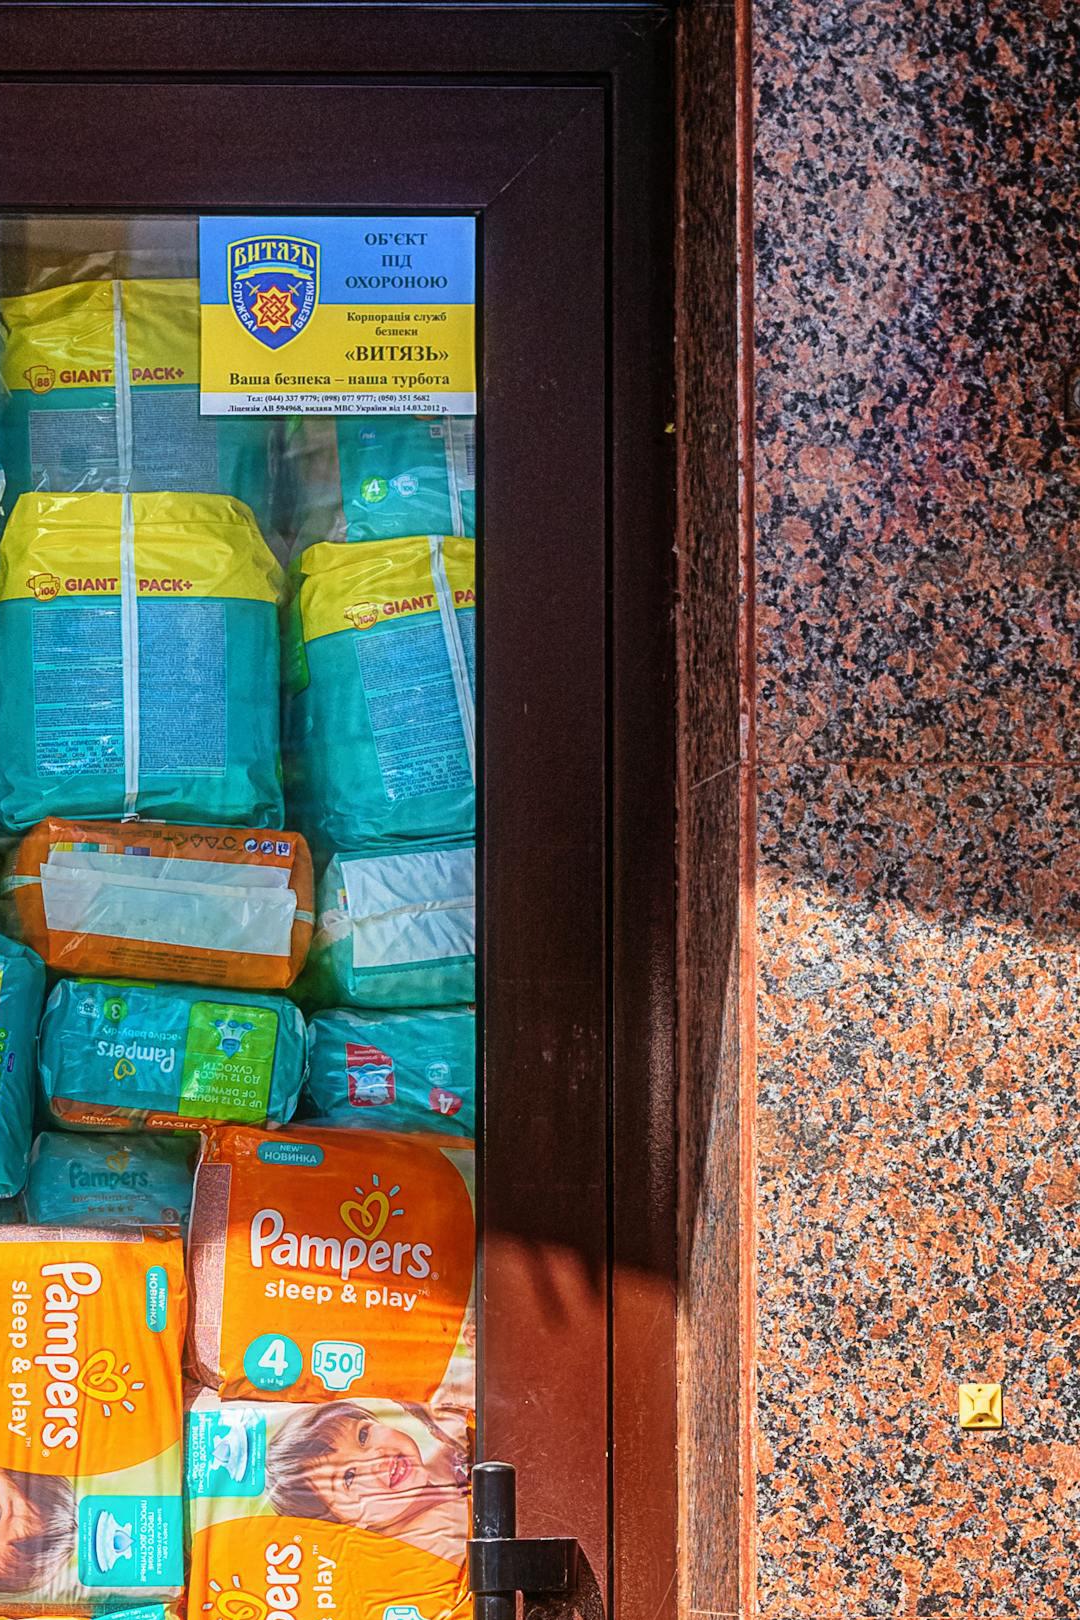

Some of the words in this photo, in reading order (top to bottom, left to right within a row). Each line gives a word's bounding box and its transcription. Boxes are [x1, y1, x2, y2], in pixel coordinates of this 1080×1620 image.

[233, 241, 315, 268] ВИТЯЗЬ
[381, 254, 412, 270] ПІД
[345, 276, 448, 289] ОХОРОНОЮ
[233, 281, 253, 329] СЛУЖБА
[294, 281, 315, 329] БЕЗПЕКИ
[347, 312, 410, 323] Корпорація
[414, 312, 447, 323] служб
[375, 325, 418, 337] безпеки
[345, 346, 449, 361] «ВИТЯЗЬ»
[37, 377, 50, 388] 88
[60, 369, 112, 383] GIANT
[132, 367, 184, 381] PACK+
[230, 373, 270, 386] Ваша
[274, 372, 331, 386] безпека
[348, 376, 388, 386] наша
[392, 373, 450, 388] турбота
[342, 394, 354, 402] 077
[398, 394, 411, 402] 351
[368, 478, 380, 495] 4
[39, 587, 56, 596] 106
[65, 578, 118, 591] GIANT
[139, 578, 193, 592] PACK+
[383, 594, 434, 615] GIANT
[111, 1004, 121, 1019] 3
[97, 1040, 175, 1073] Pampers
[203, 1062, 253, 1073] СУХОСТИ
[231, 1073, 241, 1082] 12
[244, 1075, 261, 1085] ДО
[221, 1096, 230, 1105] 12
[233, 1098, 246, 1106] TO
[242, 1090, 257, 1099] OF
[248, 1099, 263, 1108] UP
[438, 1094, 453, 1114] 4
[264, 1152, 317, 1163] НОВИНКА
[250, 1208, 433, 1281] Pampers
[149, 1273, 158, 1325] НОВИНКА
[264, 1279, 333, 1304] sleep
[340, 1284, 358, 1304] &
[365, 1286, 418, 1312] play
[8, 1280, 32, 1348] sleep
[33, 1262, 102, 1450] Pampers
[258, 1339, 289, 1377] 4
[323, 1352, 354, 1373] 50
[11, 1357, 31, 1374] &
[7, 1382, 30, 1438] play
[313, 1555, 337, 1609] play
